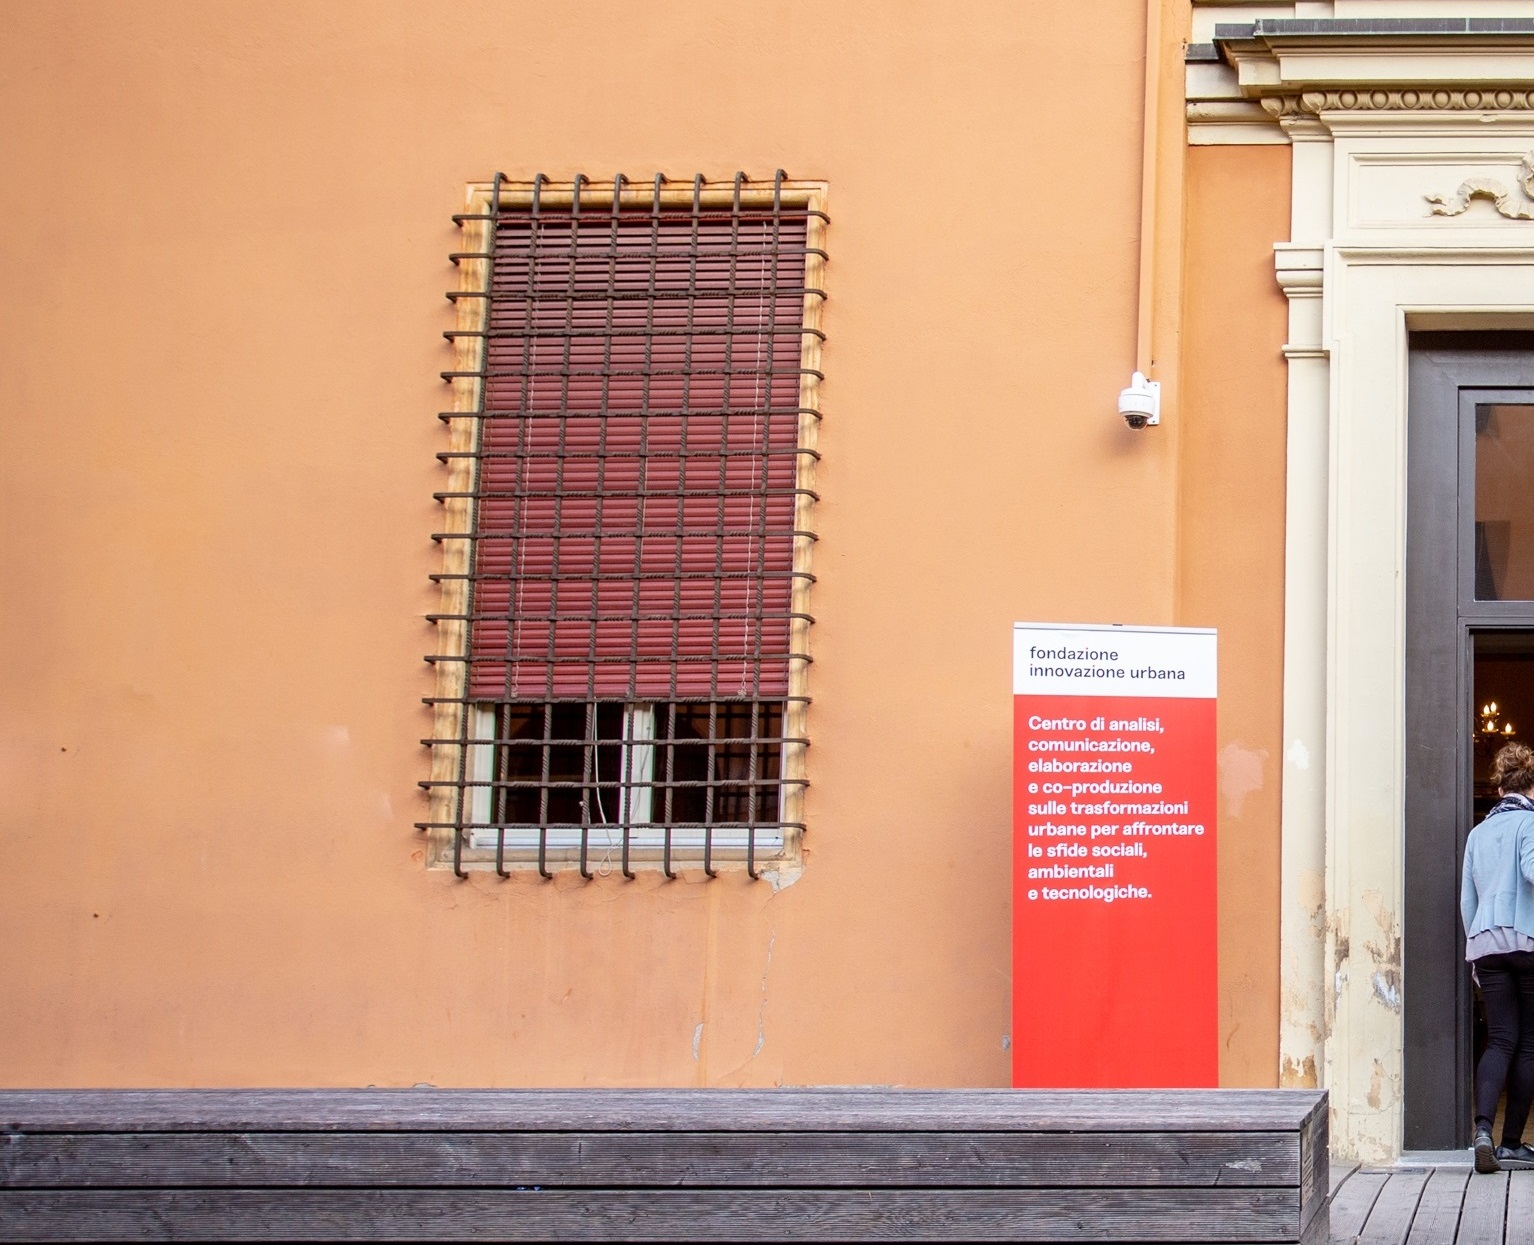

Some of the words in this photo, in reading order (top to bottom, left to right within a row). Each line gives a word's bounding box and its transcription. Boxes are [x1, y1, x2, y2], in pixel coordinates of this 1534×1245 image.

[1030, 646, 1118, 660] fondazione
[1029, 663, 1125, 679] innovazione
[1130, 666, 1186, 680] urbana
[1029, 716, 1086, 730] Centro
[1090, 717, 1105, 731] di
[1109, 717, 1164, 733] analisi,
[1028, 738, 1155, 754] comunicazione,
[1028, 758, 1132, 773] elaborazione
[1028, 783, 1038, 793] e
[1042, 780, 1162, 797] co-produzione
[1028, 801, 1067, 815] sulle
[1070, 801, 1188, 815] trasformazioni
[1028, 822, 1086, 836] urbane
[1091, 825, 1119, 839] per
[1123, 822, 1204, 835] affrontare
[1028, 843, 1042, 857] le
[1047, 843, 1088, 857] sfide
[1092, 842, 1147, 858] sociali,
[1028, 864, 1113, 878] ambientali
[1028, 889, 1038, 900] e
[1042, 884, 1152, 902] tecnologiche.
